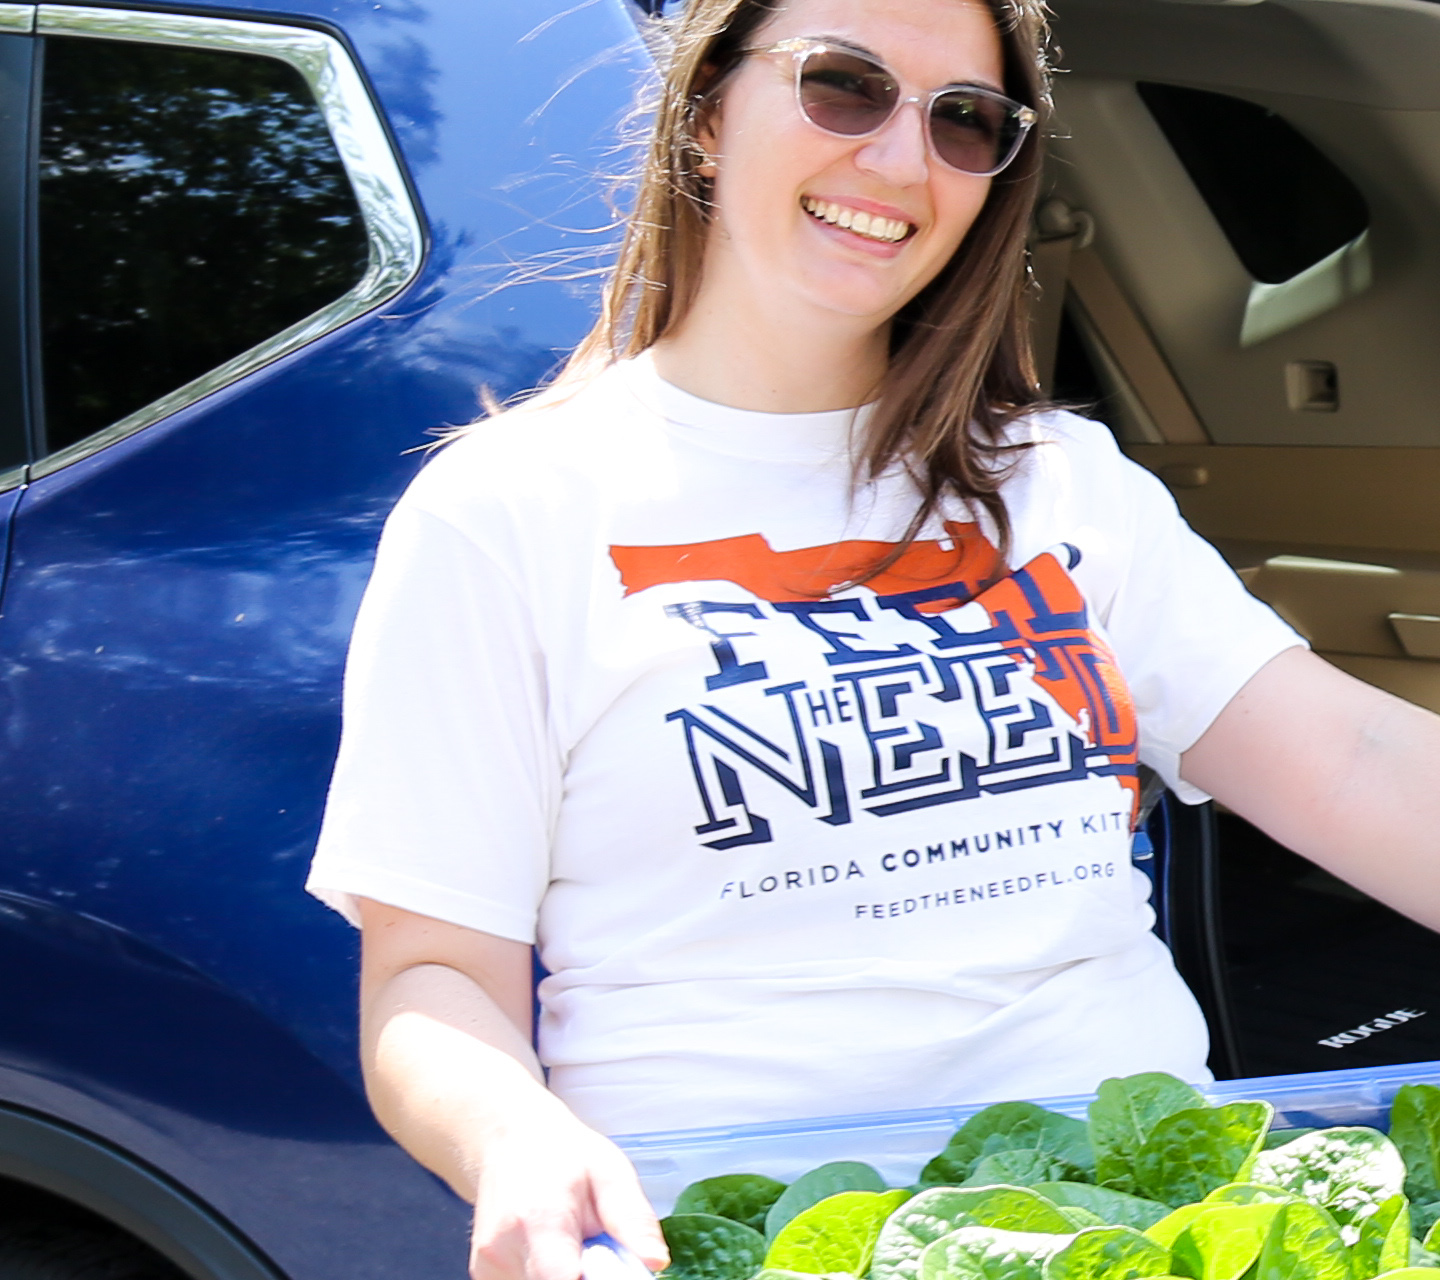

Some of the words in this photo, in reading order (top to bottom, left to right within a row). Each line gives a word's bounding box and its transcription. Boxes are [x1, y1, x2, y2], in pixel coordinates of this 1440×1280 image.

[665, 634, 1138, 851] NEED
[719, 859, 865, 900] FLORIDA
[880, 819, 1066, 873] COMMUNITY
[1080, 811, 1131, 835] KIT
[854, 861, 1116, 919] FEEDTHENEEDFL.ORG
[1317, 1006, 1428, 1049] ROGUE
